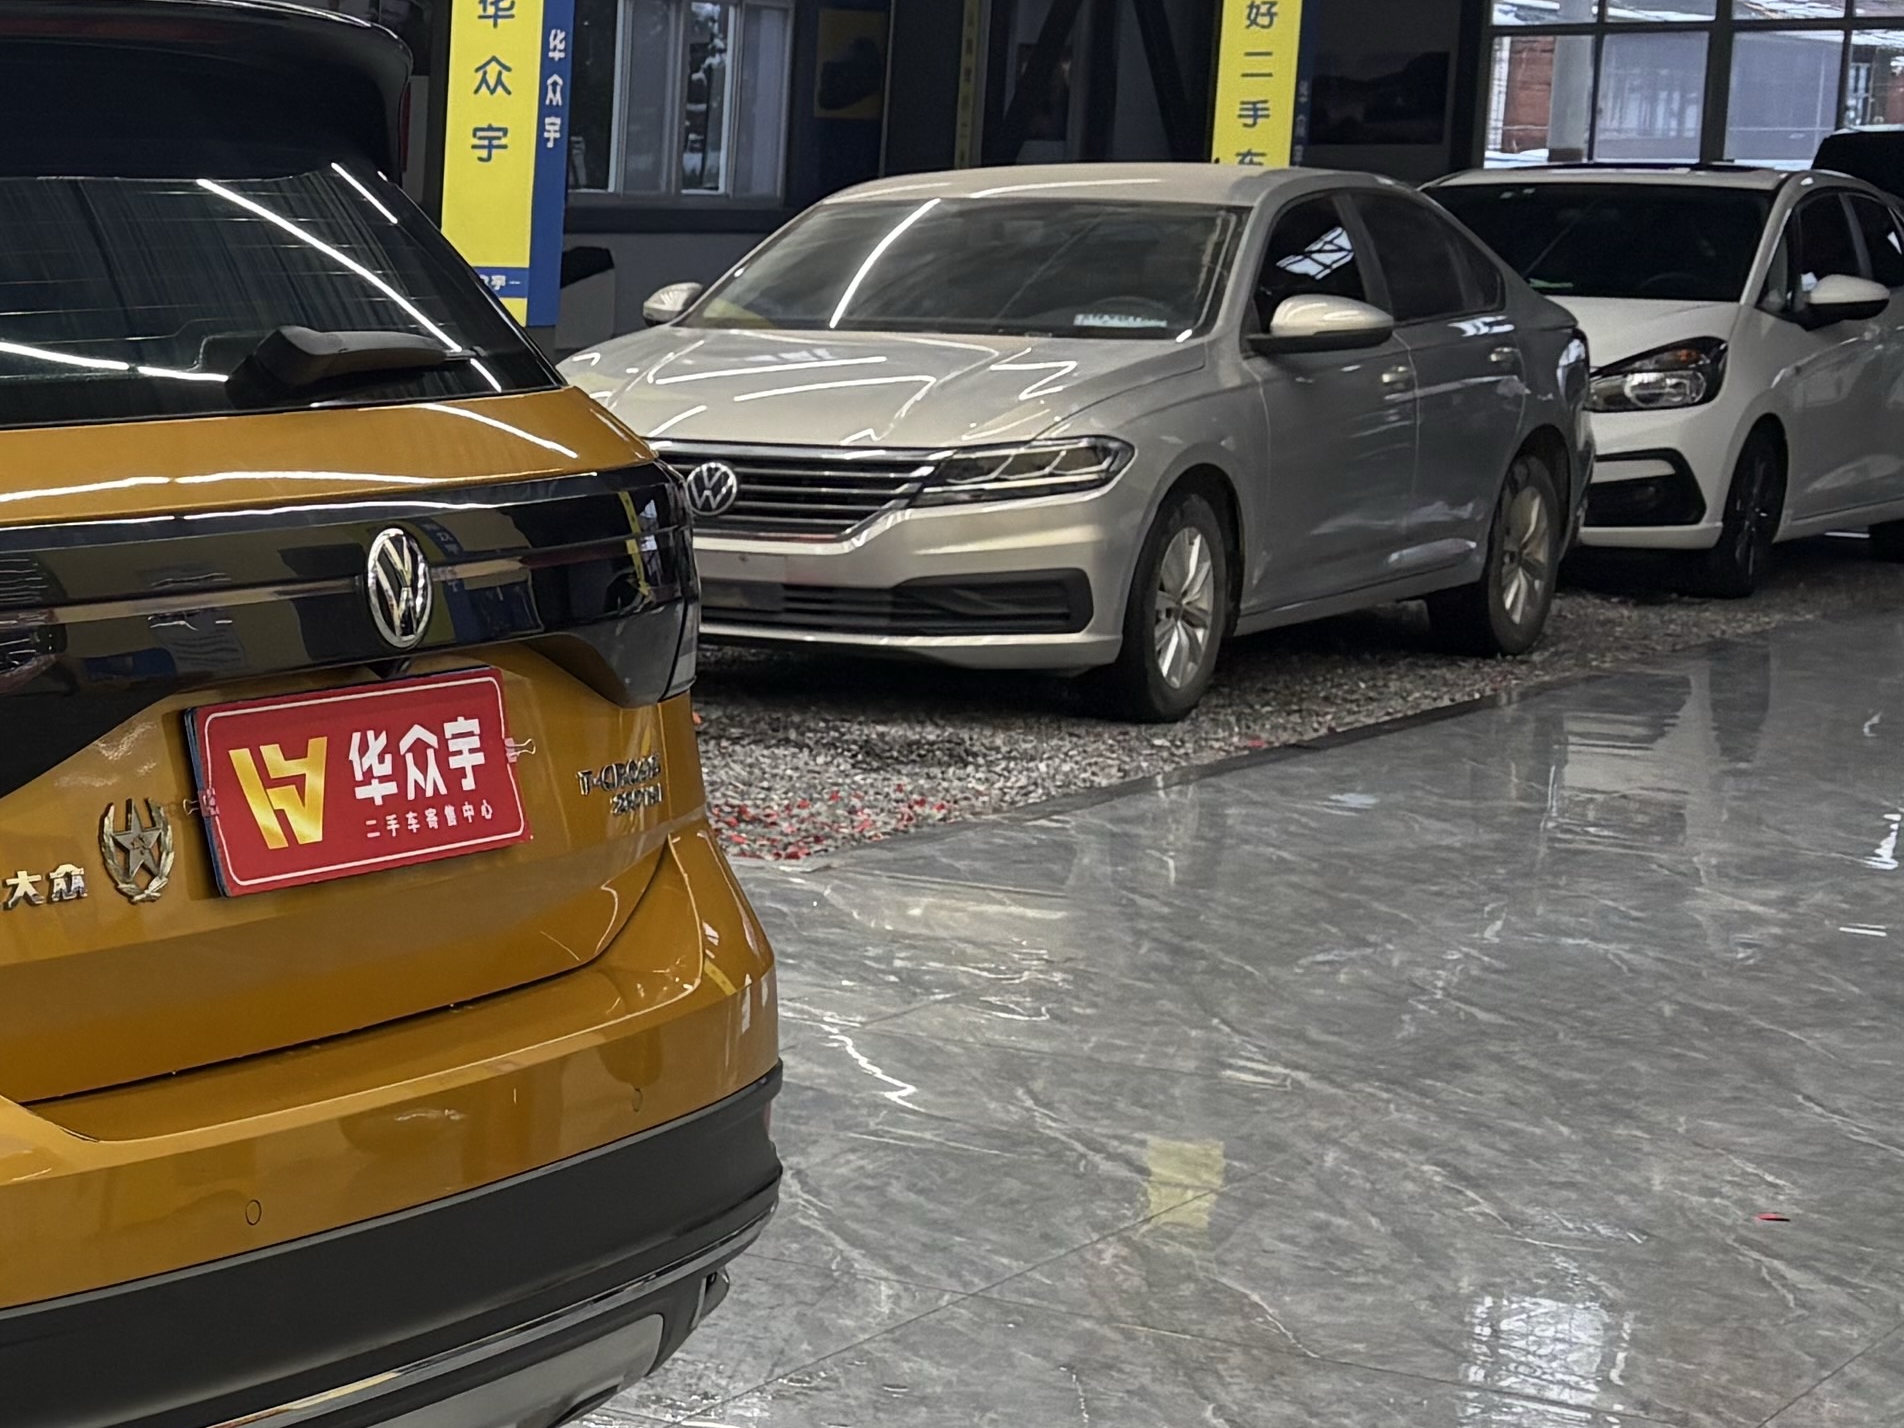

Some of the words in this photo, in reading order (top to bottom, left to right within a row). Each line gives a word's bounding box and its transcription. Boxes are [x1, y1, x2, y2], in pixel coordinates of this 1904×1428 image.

[543, 28, 567, 149] 华众宇
[348, 716, 485, 806] 华众宇
[365, 799, 494, 839] 二手车寄售中心
